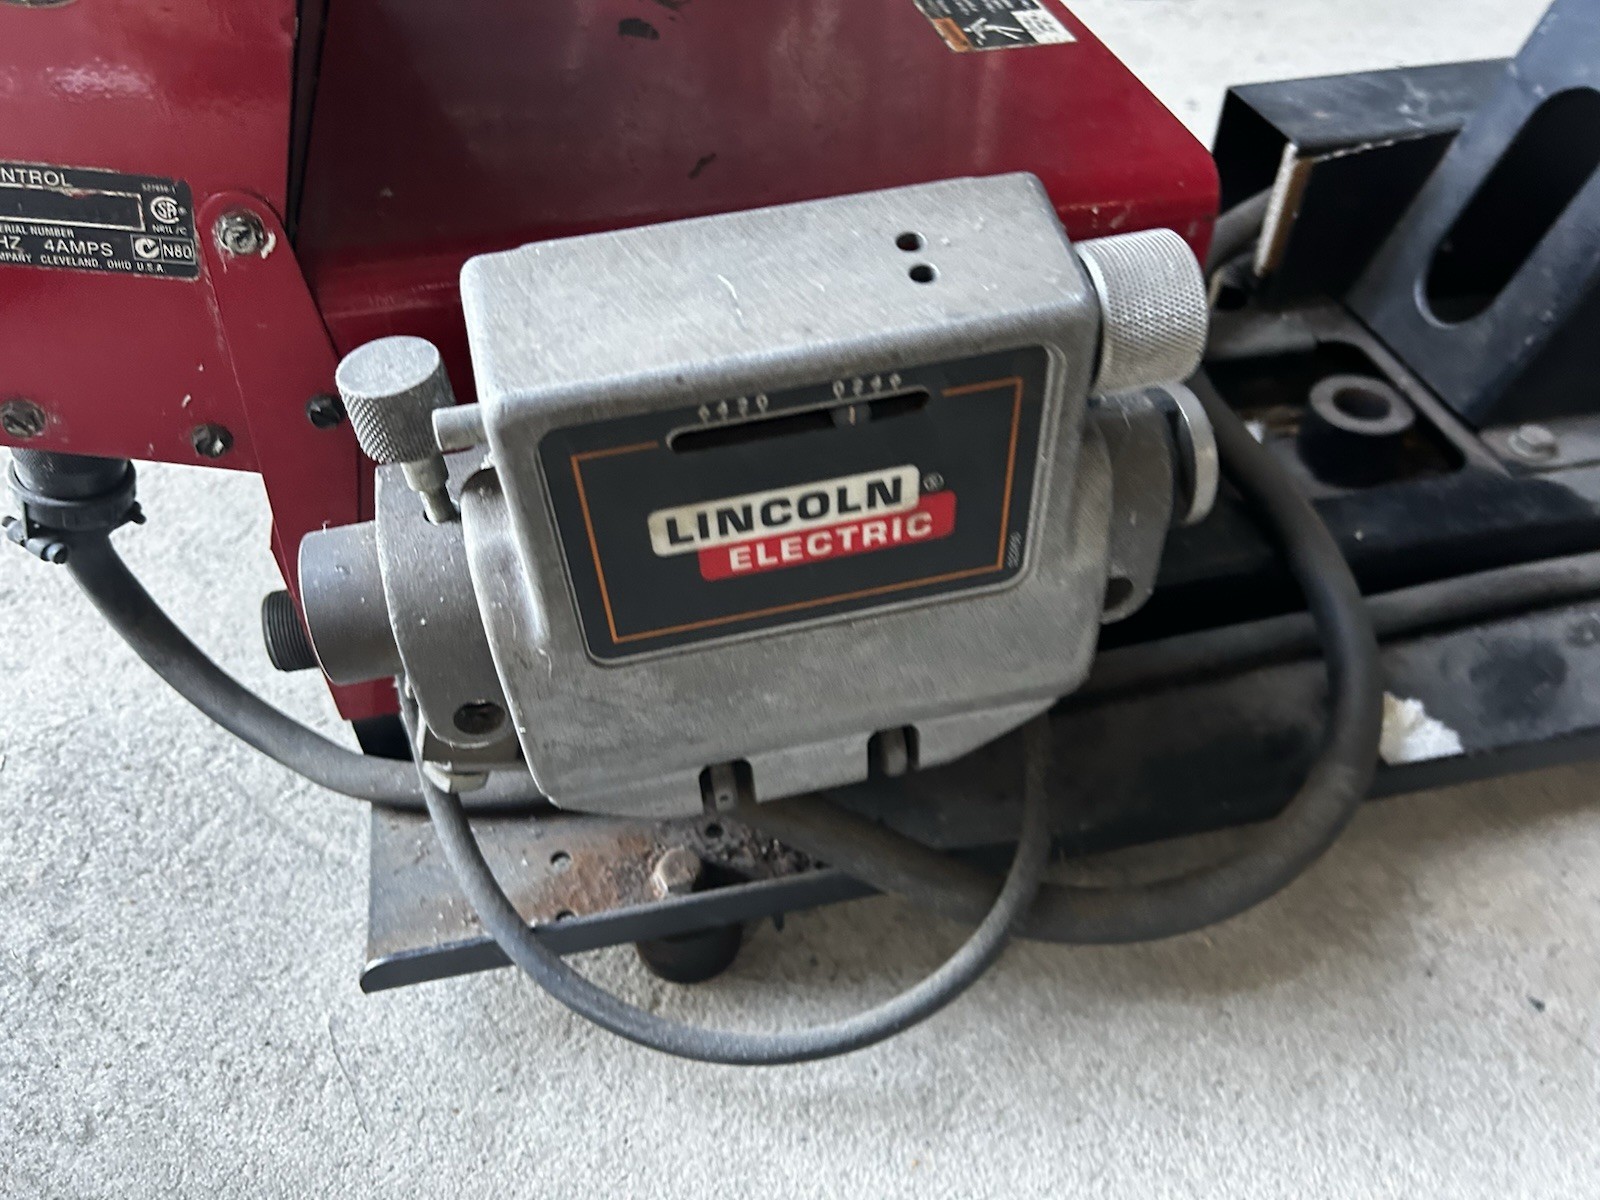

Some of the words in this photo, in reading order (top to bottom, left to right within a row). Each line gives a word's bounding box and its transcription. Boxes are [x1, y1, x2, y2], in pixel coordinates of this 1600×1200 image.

[30, 225, 75, 239] NUMBER
[107, 260, 132, 271] OHIO
[665, 476, 902, 547] LINCOLN
[728, 511, 933, 573] ELECTRIC
